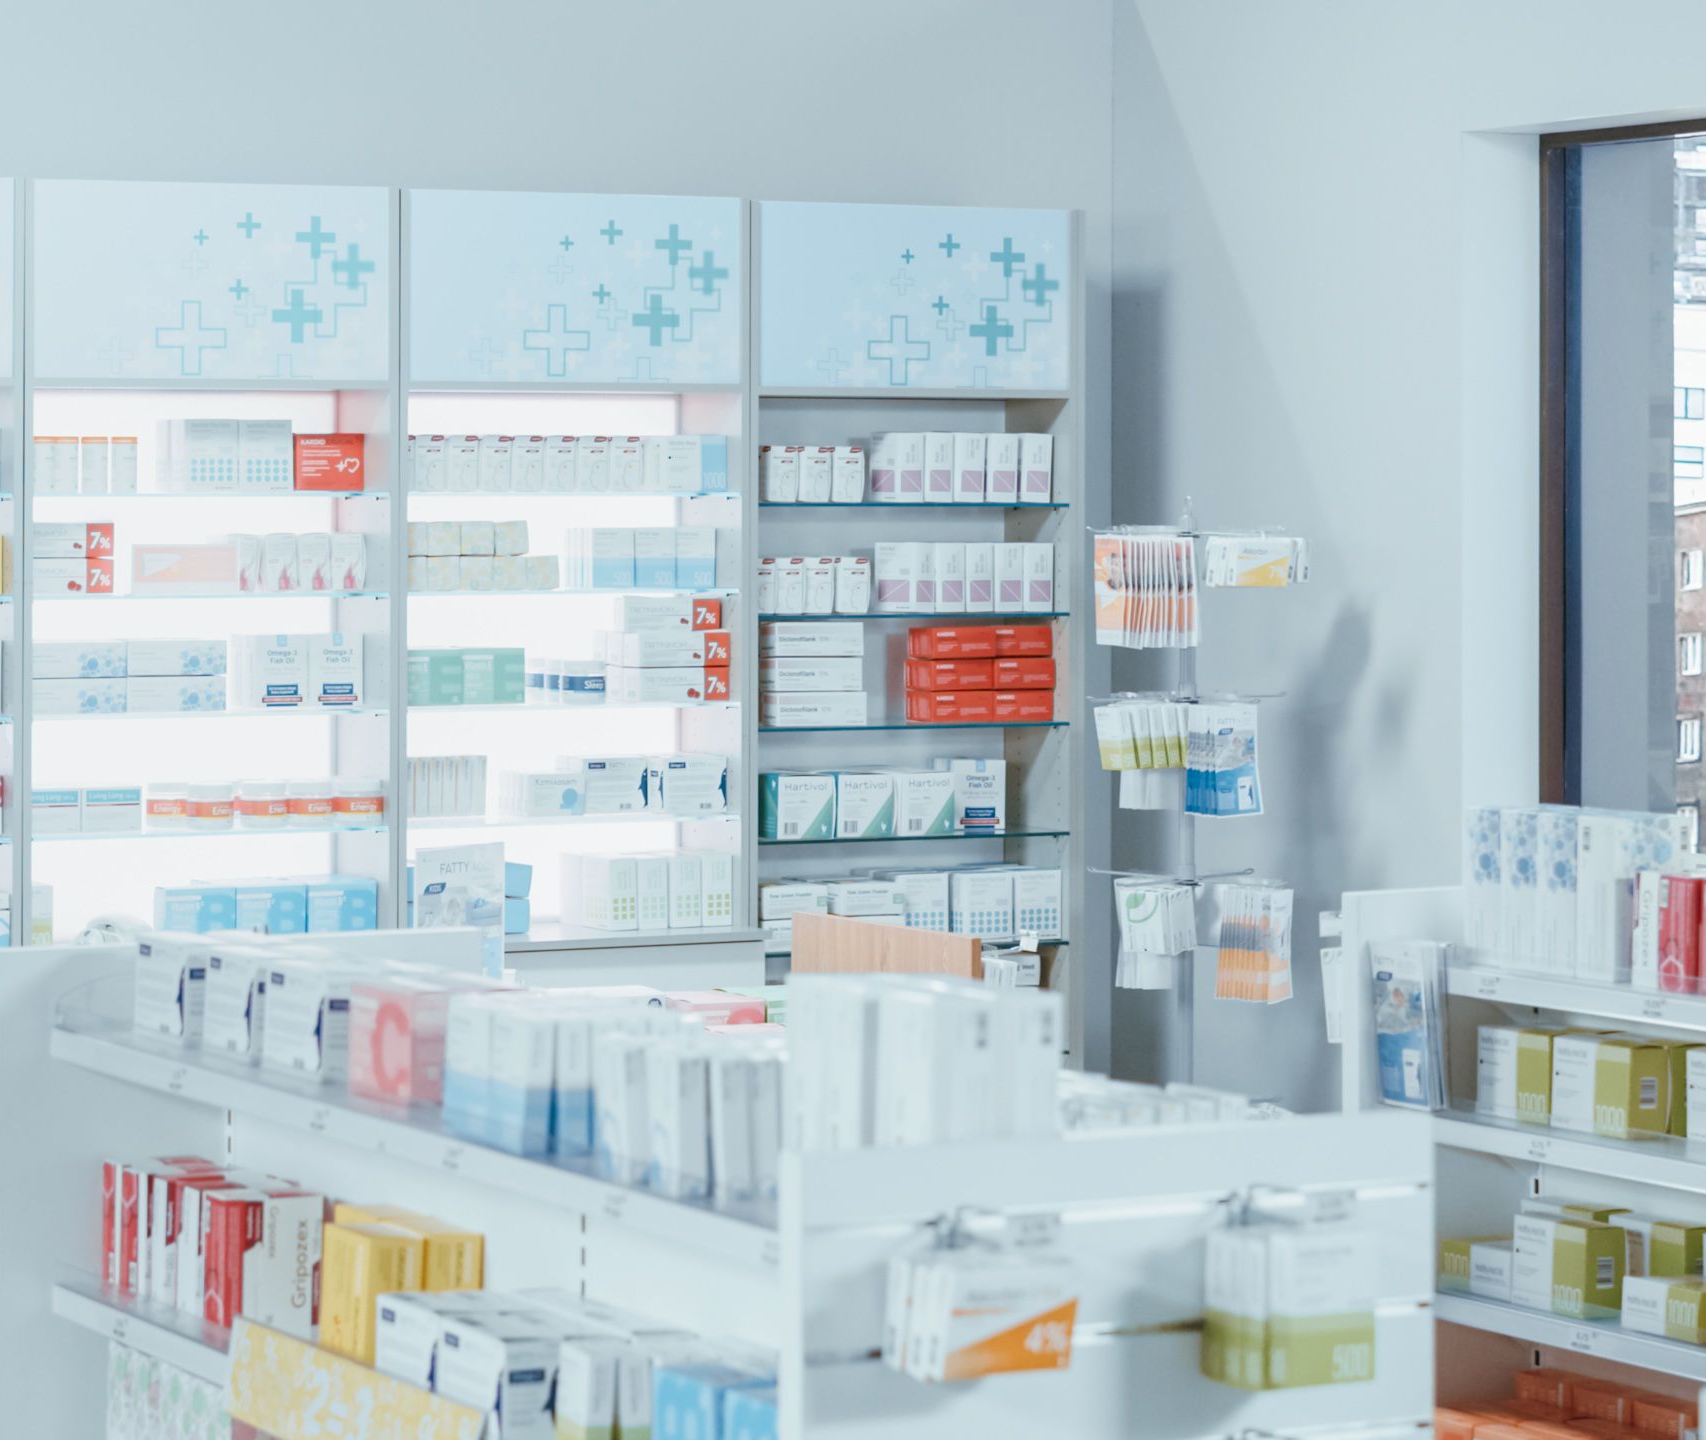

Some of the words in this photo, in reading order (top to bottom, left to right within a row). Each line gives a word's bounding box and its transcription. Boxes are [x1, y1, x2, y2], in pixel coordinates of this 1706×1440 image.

[704, 472, 726, 488] 1000
[90, 531, 111, 550] 7%
[90, 568, 111, 587] 7%
[613, 572, 631, 585] 500
[655, 571, 671, 585] 500
[695, 571, 711, 585] 500
[697, 608, 716, 624] 7%
[267, 650, 298, 658] Omega-3
[323, 649, 353, 657] Omega-3
[708, 642, 726, 659] 7%
[270, 656, 285, 664] Fish
[286, 656, 295, 664] Oil
[325, 656, 340, 664] Fish
[341, 656, 350, 664] Oil
[584, 679, 604, 690] Sleep
[708, 677, 726, 694] 7%
[845, 780, 888, 790] Hartivol
[908, 778, 951, 788] Hartivol
[966, 774, 996, 782] Omega-3
[784, 781, 828, 792] Hartivol
[153, 804, 182, 815] Energy
[350, 801, 377, 813] Energy
[440, 862, 469, 874] FATTY
[1641, 889, 1651, 968] Gripozex
[1518, 1093, 1547, 1112] 1000
[1595, 1104, 1626, 1128] 1000
[291, 1219, 310, 1309] Gripozex
[1553, 1285, 1583, 1313] 1000
[1667, 1303, 1697, 1327] 1000
[1024, 1321, 1068, 1354] 4%
[1332, 1342, 1370, 1379] 500
